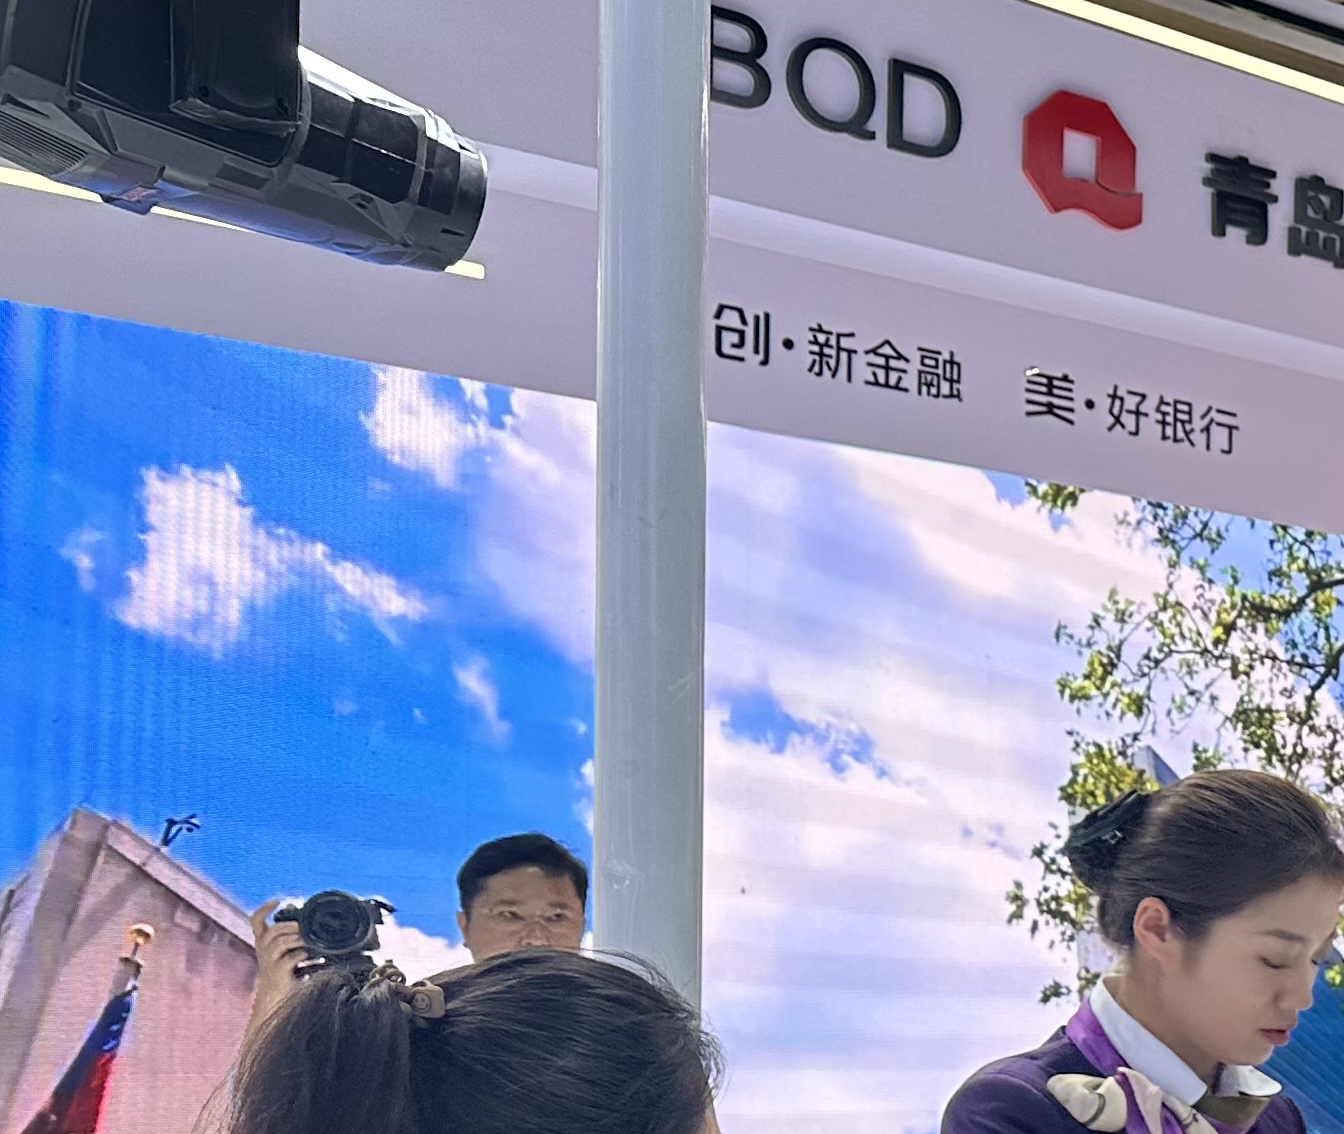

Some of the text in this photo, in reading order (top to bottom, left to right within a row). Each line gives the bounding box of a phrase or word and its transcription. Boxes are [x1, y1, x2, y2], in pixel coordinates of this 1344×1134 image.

[709, 4, 963, 159] BQD
[1023, 369, 1240, 456] 美·好银行
